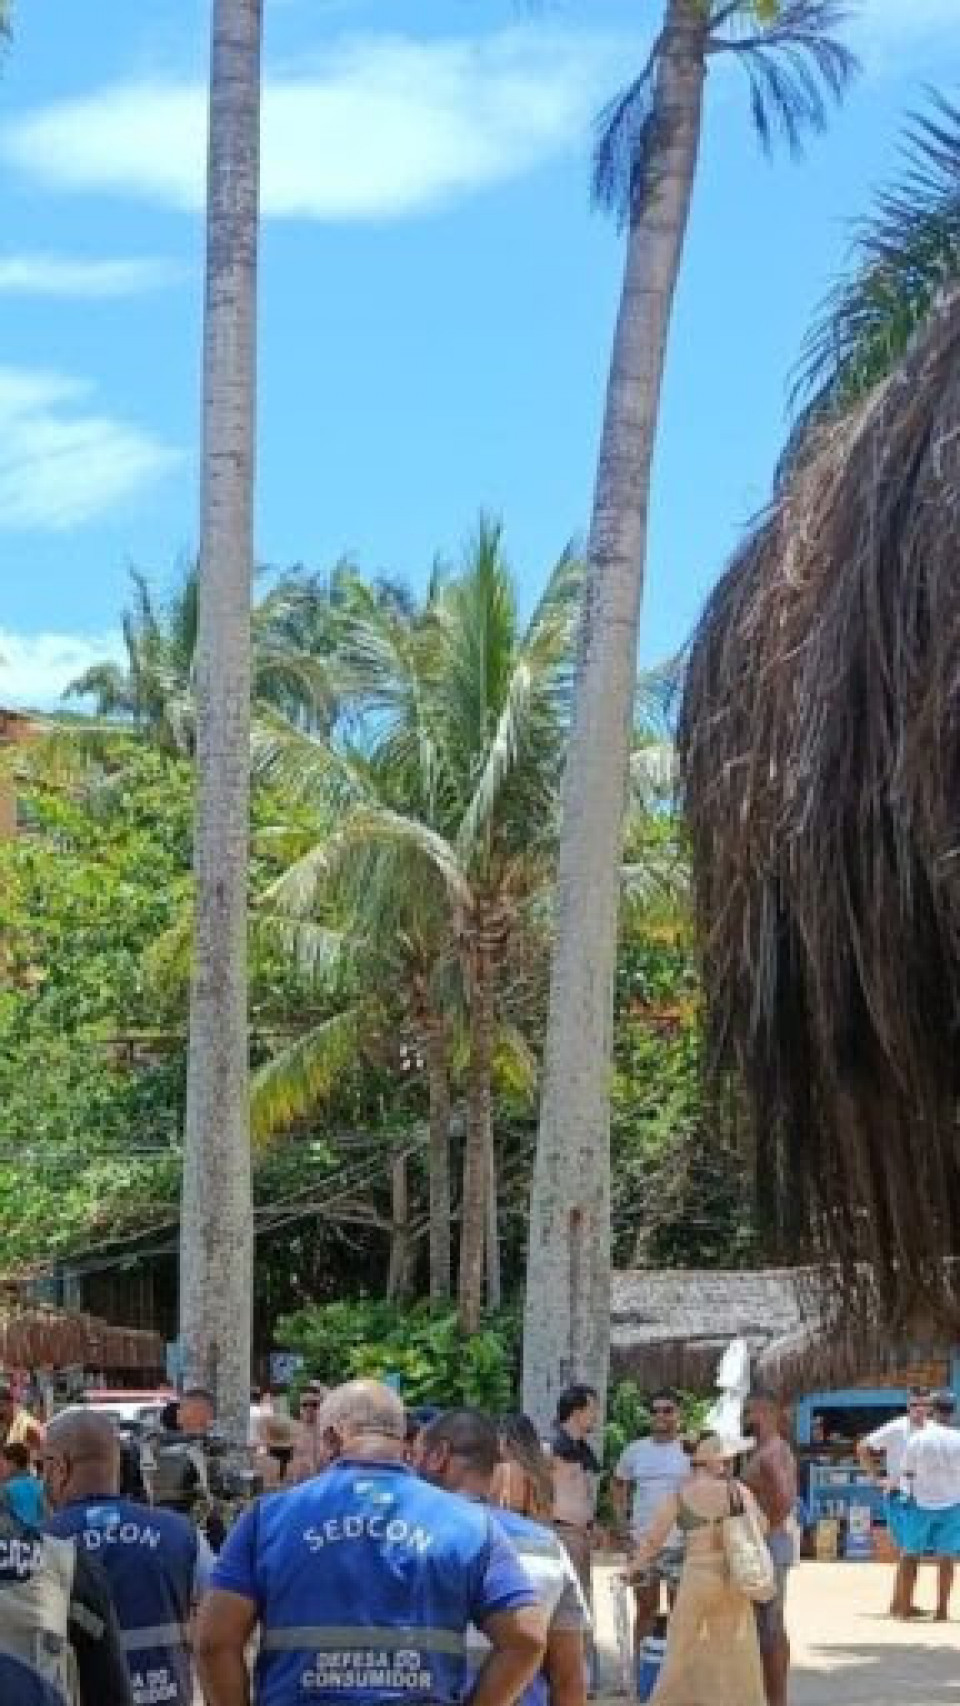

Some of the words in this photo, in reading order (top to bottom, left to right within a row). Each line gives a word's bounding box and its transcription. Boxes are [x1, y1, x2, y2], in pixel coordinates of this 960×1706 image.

[81, 1521, 161, 1550] DCON
[302, 1514, 435, 1553] SEDCON
[316, 1652, 388, 1668] DEFESA
[394, 1649, 421, 1671] DO
[302, 1669, 431, 1690] CONSUMIDOR
